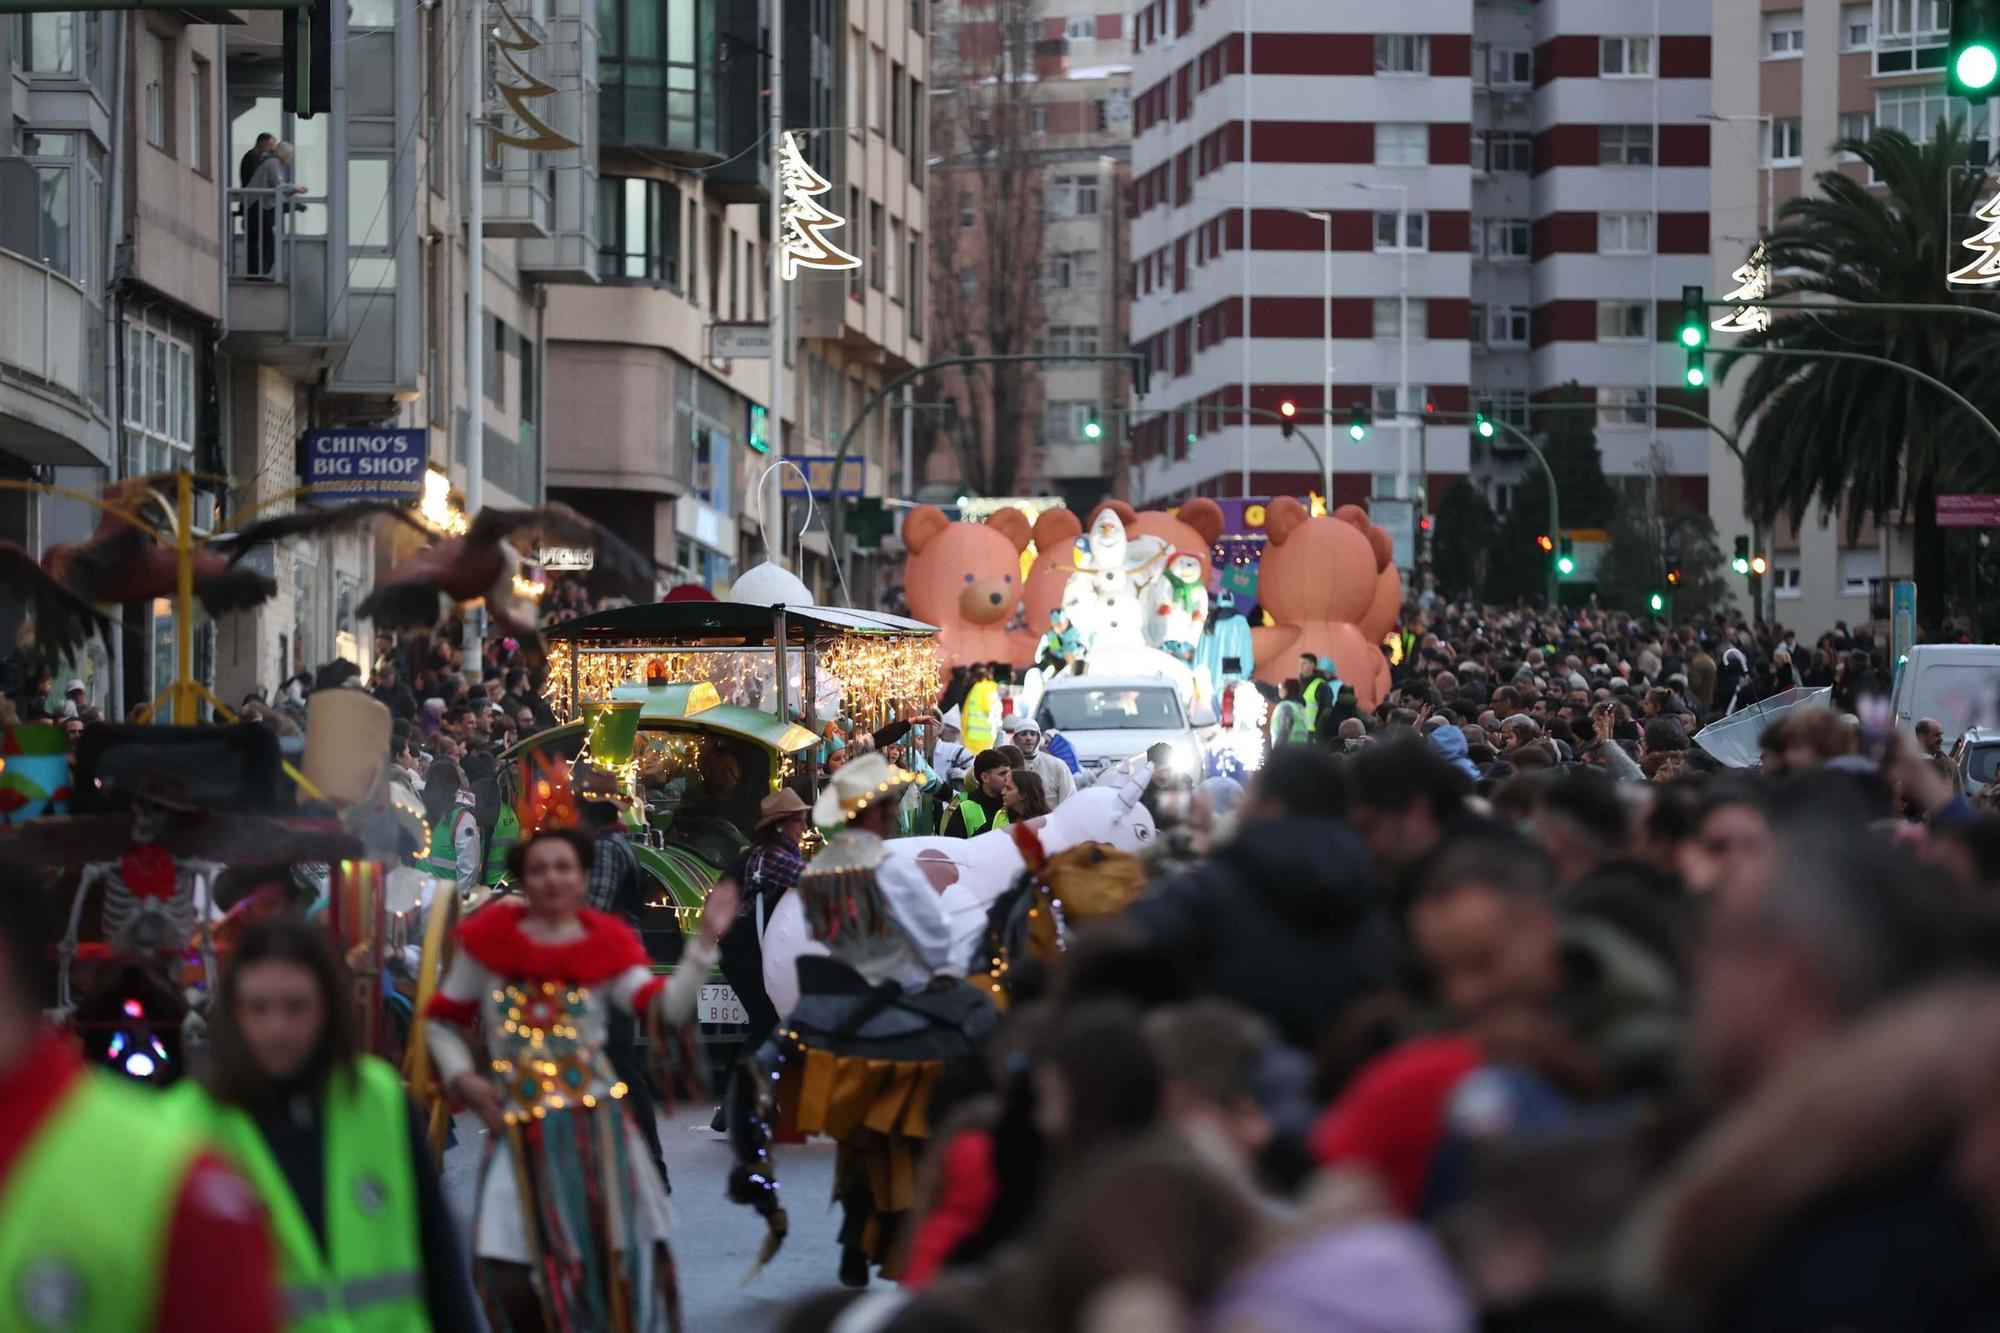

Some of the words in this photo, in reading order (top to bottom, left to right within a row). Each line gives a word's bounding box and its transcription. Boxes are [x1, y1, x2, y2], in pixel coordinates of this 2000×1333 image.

[316, 436, 408, 454] CHINO'S
[313, 457, 352, 475] BIG
[358, 456, 419, 475] SHOP
[710, 1006, 740, 1021] BGC
